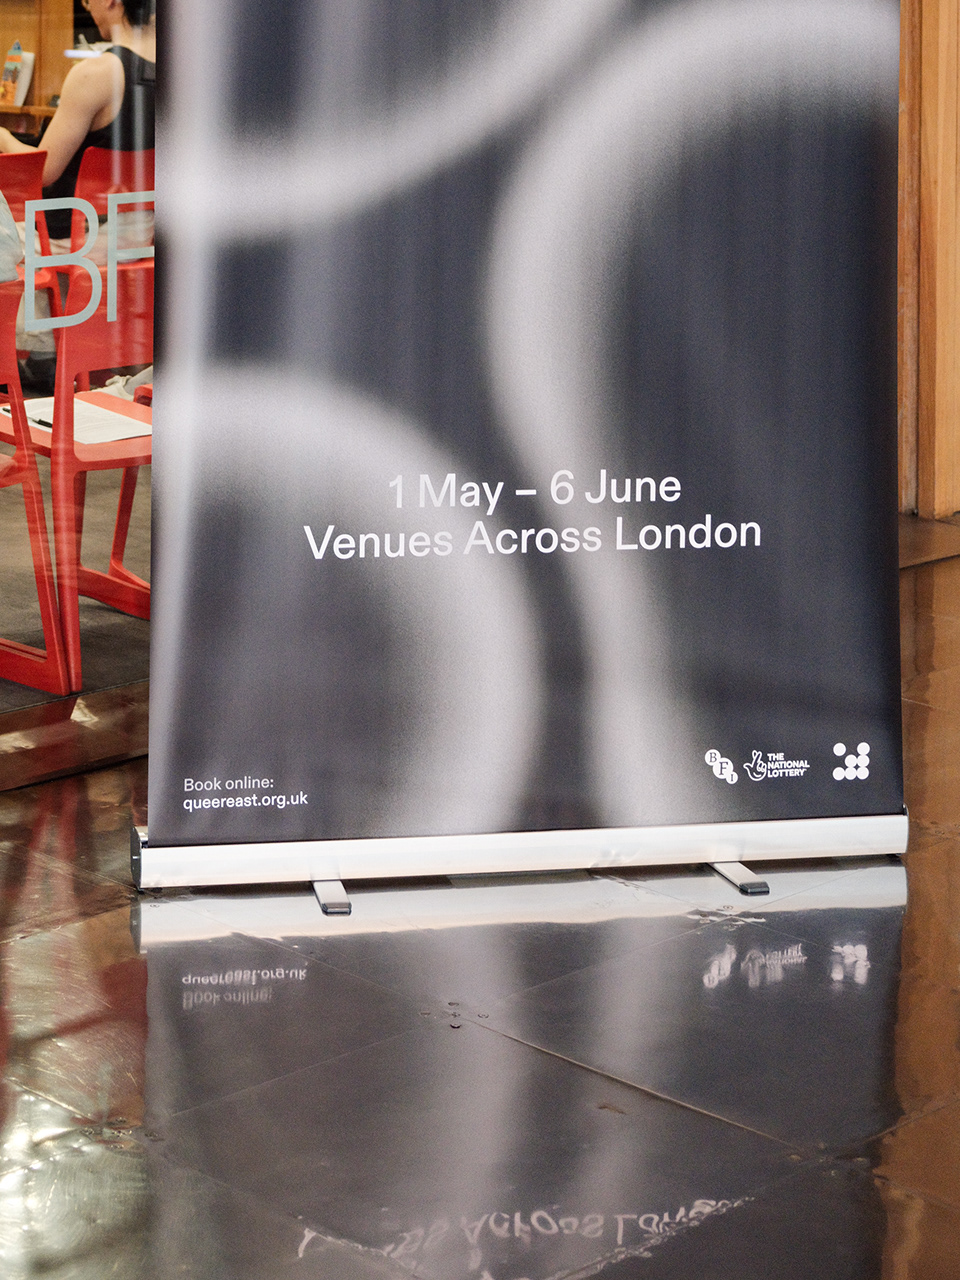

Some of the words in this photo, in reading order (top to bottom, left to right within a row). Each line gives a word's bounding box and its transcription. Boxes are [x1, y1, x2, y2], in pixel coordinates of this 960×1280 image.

[389, 475, 403, 508] 1
[420, 473, 504, 515] May
[550, 470, 574, 505] 6
[585, 469, 682, 505] June
[303, 525, 453, 560] Venues
[463, 521, 603, 555] Across
[616, 514, 761, 551] London
[767, 753, 784, 761] THE
[767, 760, 810, 769] NATIONAL
[767, 769, 807, 778] LOTTERY
[184, 777, 222, 792] Book
[225, 776, 274, 790] online:
[183, 791, 308, 812] queereast.org.uk
